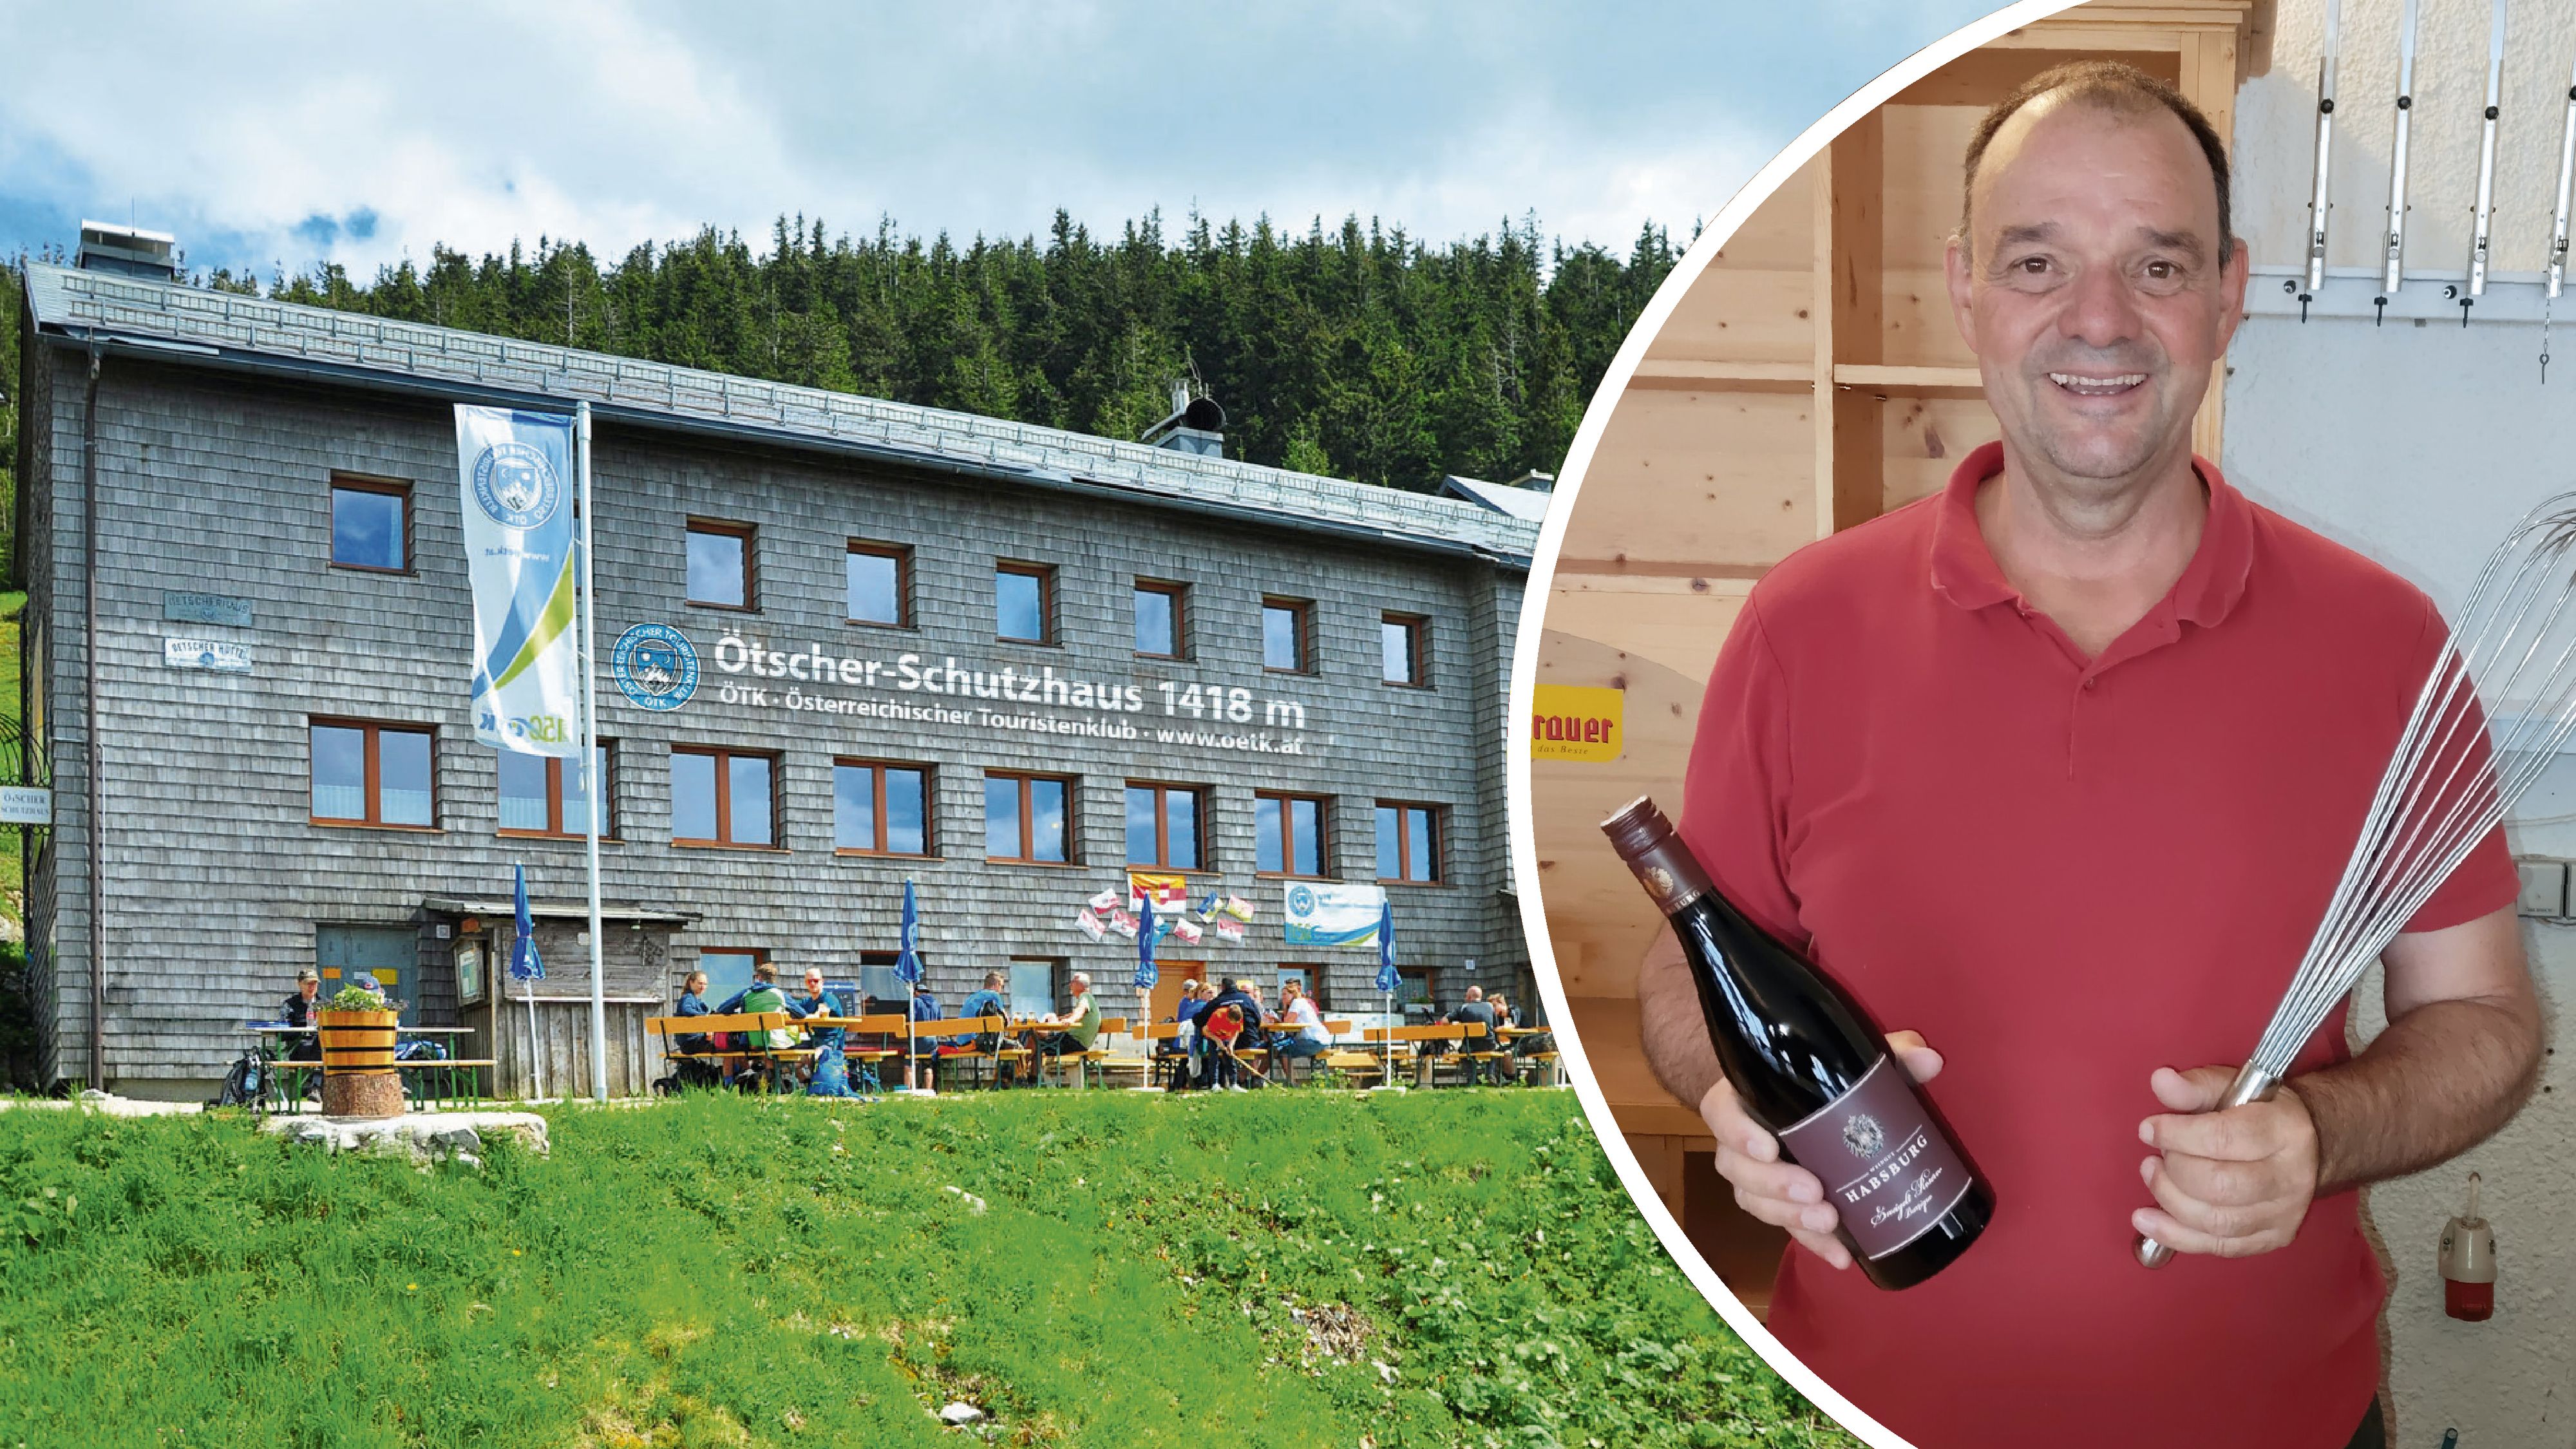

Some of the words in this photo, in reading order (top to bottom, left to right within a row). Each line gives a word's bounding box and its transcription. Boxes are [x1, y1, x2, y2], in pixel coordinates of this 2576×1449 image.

[715, 628, 1144, 712] Ötscher-Schutzhaus
[1159, 681, 1252, 723] 1418
[1265, 698, 1305, 730] m
[721, 680, 768, 708] ÖTK
[786, 687, 972, 724] Österreichischer
[980, 708, 1137, 740] Touristenklub
[1157, 728, 1303, 755] www.oetk.at
[1537, 744, 1555, 753] das
[1560, 745, 1589, 755] Beste
[1844, 1134, 1927, 1203] HABSBURG
